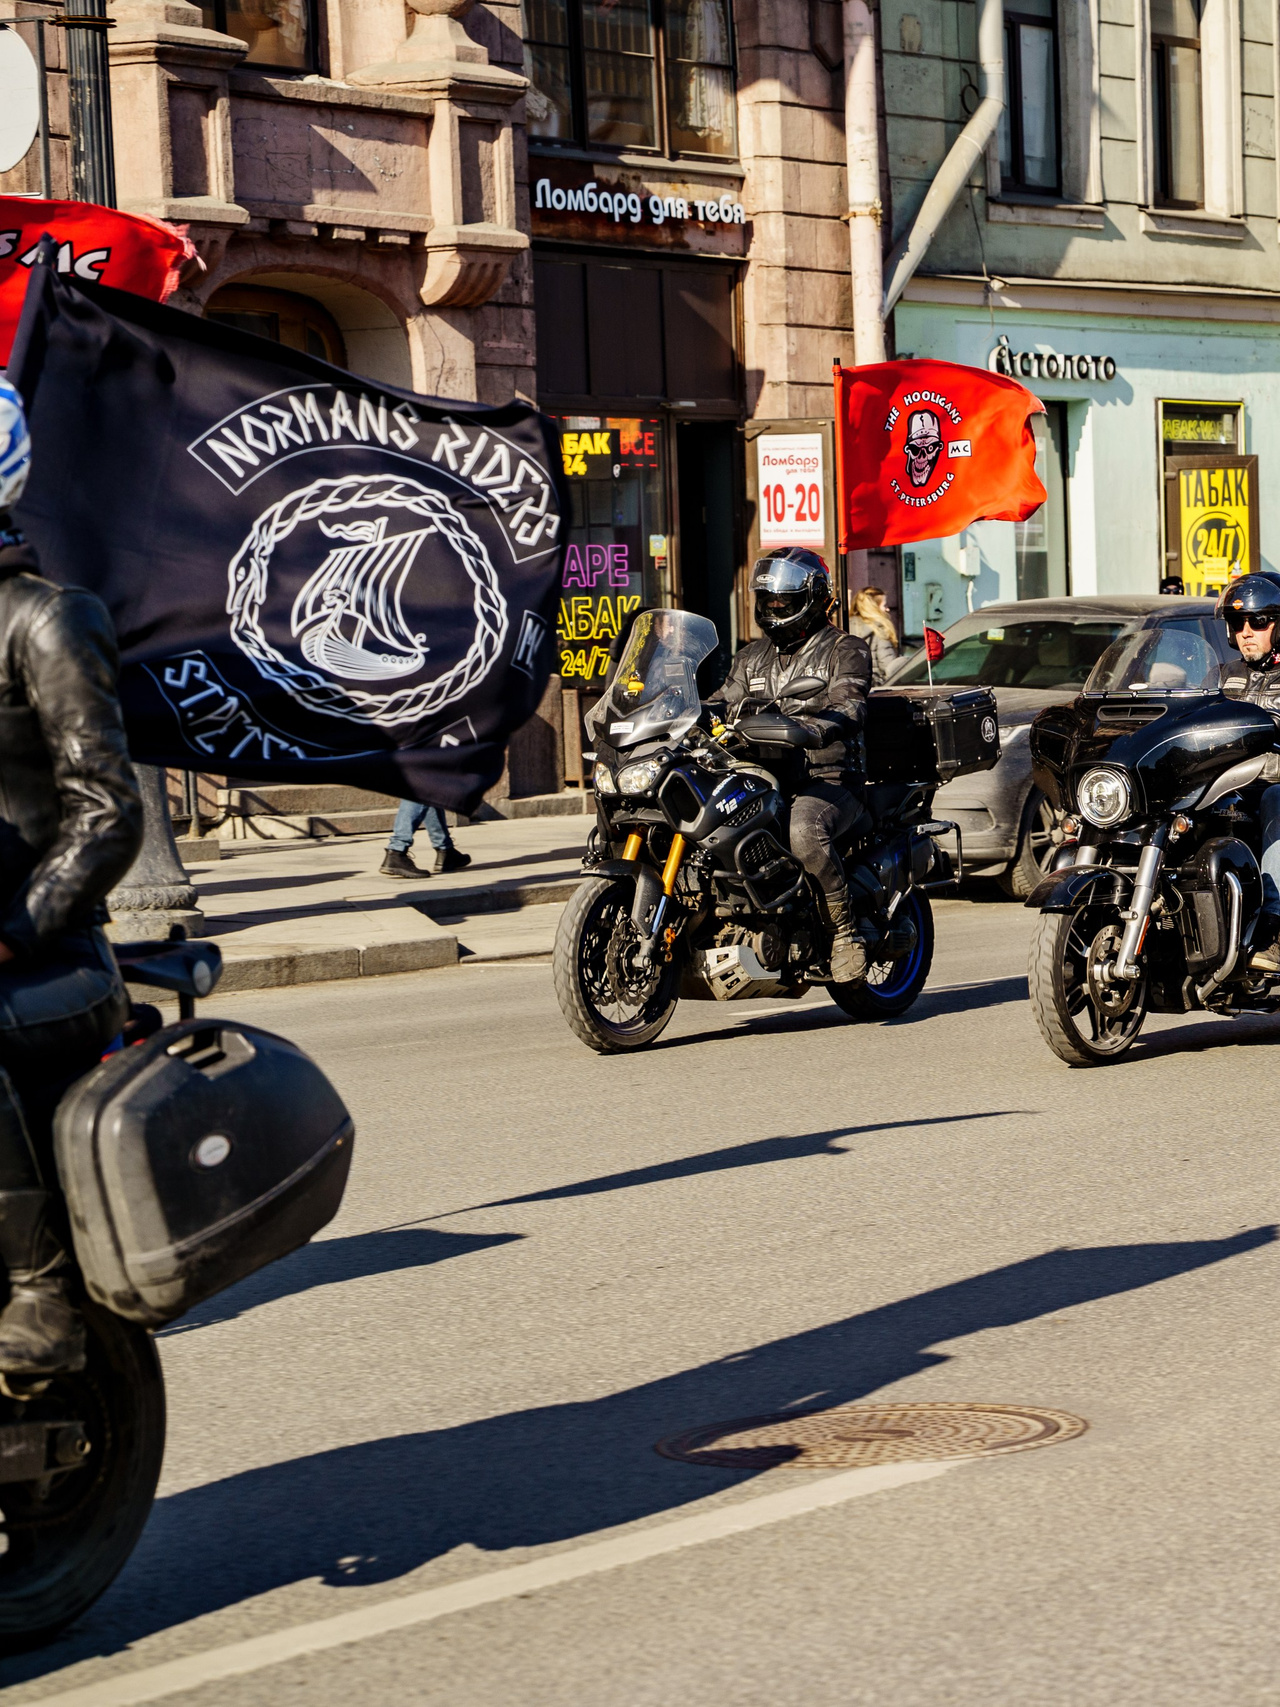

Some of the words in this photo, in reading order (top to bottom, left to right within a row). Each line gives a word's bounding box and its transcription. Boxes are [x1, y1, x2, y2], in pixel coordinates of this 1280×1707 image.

[535, 178, 643, 223] Ломбард
[649, 195, 689, 225] для
[694, 194, 746, 224] тебя
[885, 406, 901, 432] THE
[903, 390, 962, 425] HOOLIGANS
[562, 432, 611, 455] БАК
[762, 454, 819, 468] Ломбард
[206, 390, 422, 478] NORMANS
[431, 416, 560, 546] RIDERS
[1182, 468, 1248, 508] ТАБАК
[762, 483, 820, 523] 10-20
[562, 544, 630, 588] APE
[556, 595, 641, 641] АБАК
